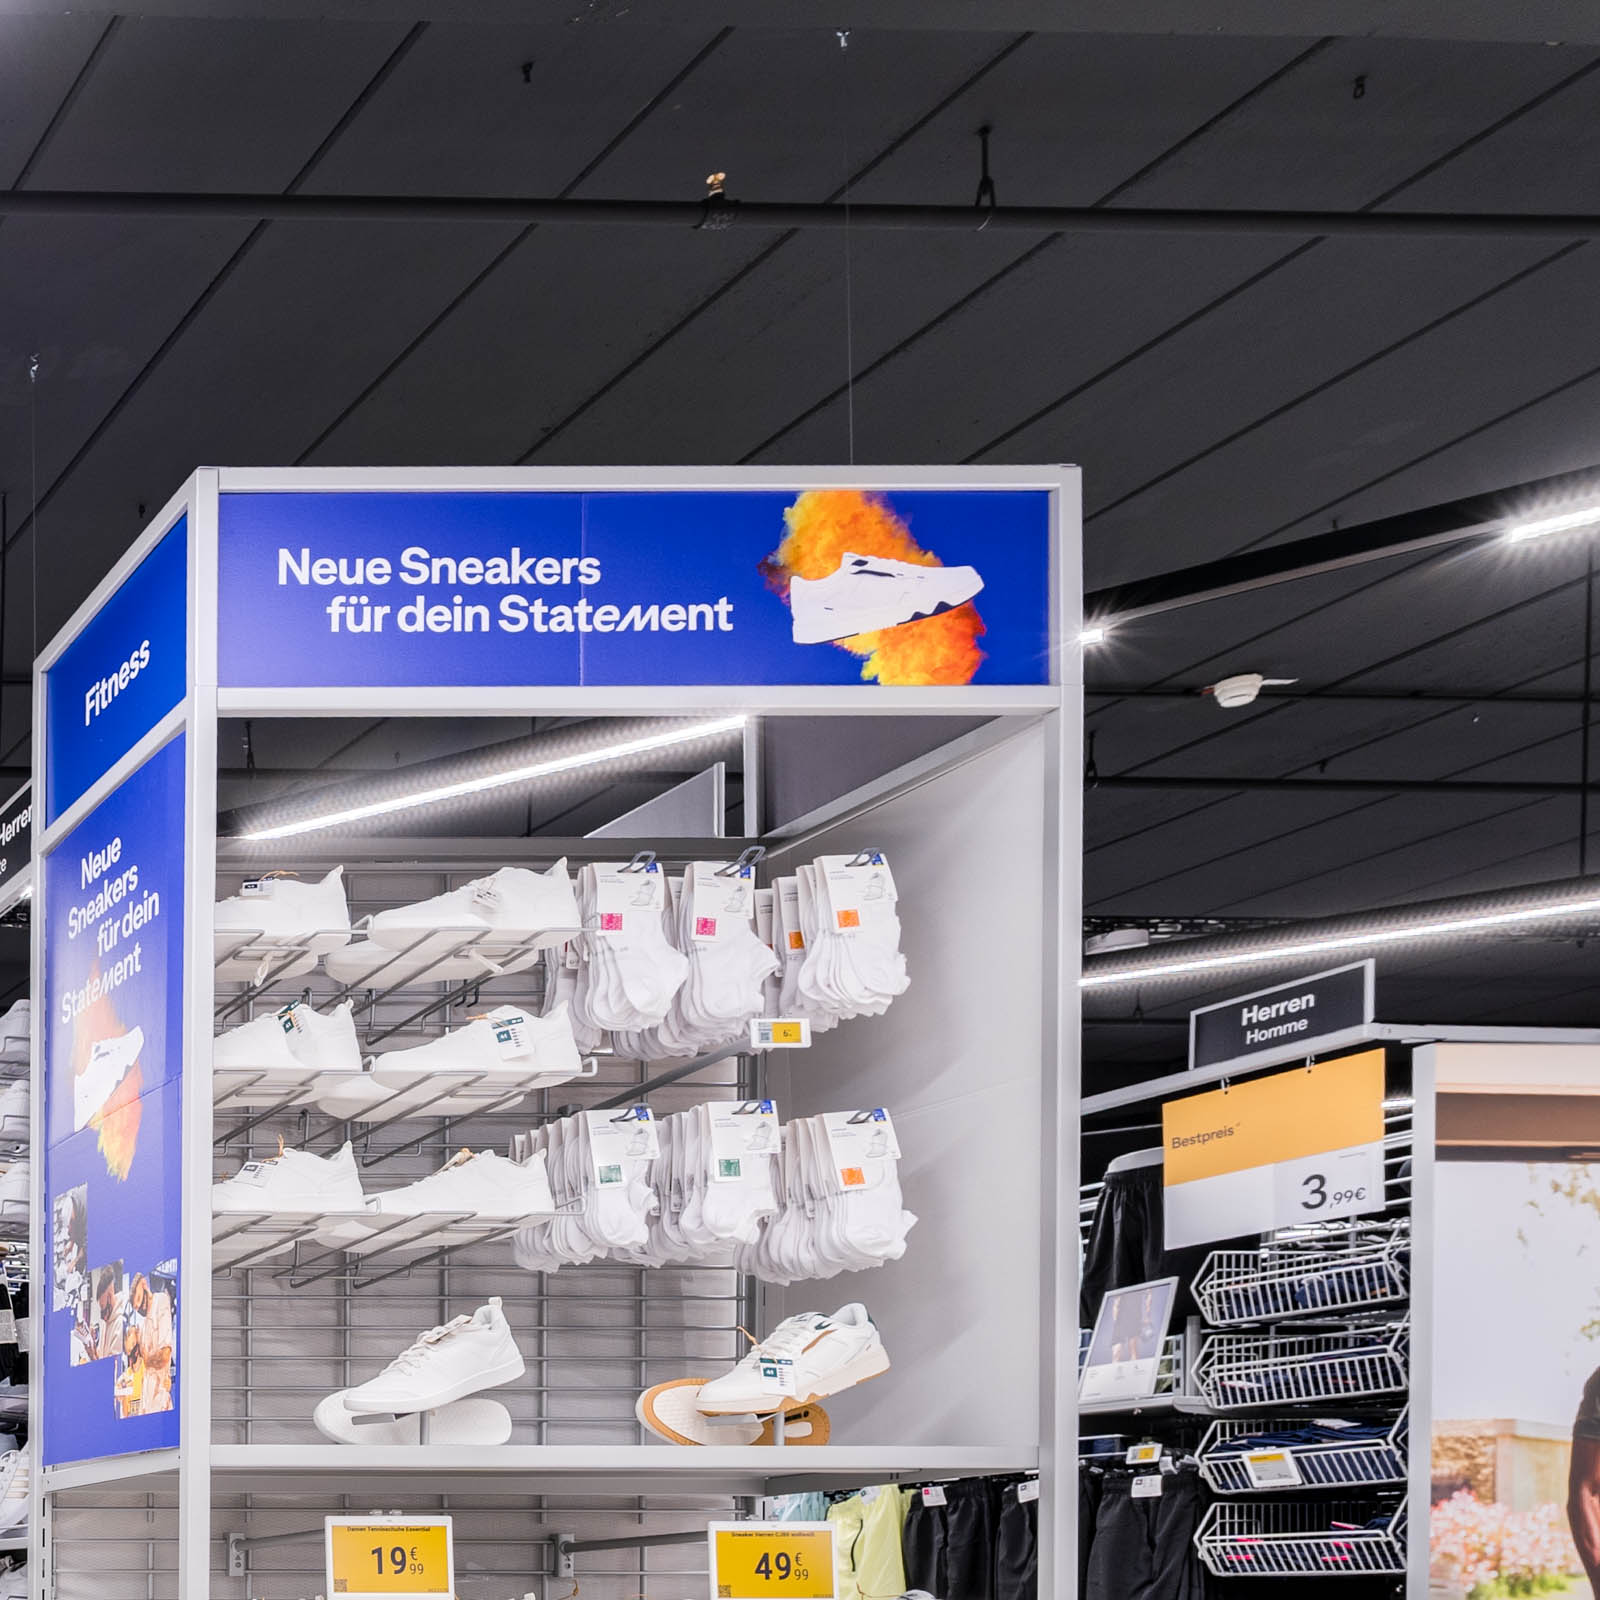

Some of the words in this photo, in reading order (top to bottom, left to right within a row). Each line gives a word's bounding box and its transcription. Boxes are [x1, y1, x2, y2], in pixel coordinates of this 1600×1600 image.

[278, 547, 392, 586] Neue
[401, 546, 600, 586] Sneakers
[326, 595, 391, 633] für
[398, 595, 491, 633] dein
[499, 596, 734, 634] Statement
[84, 639, 151, 727] Fitness
[80, 836, 122, 890] Neue
[68, 864, 139, 940] Sneakers
[97, 918, 120, 957] für
[121, 890, 160, 943] dein
[61, 944, 143, 1027] Statement
[1241, 993, 1315, 1027] Herren
[1246, 1018, 1308, 1045] Homme
[371, 1547, 407, 1575] 19
[410, 1547, 418, 1560] €
[410, 1563, 424, 1575] 99
[754, 1552, 791, 1580] 49
[795, 1552, 803, 1566] €
[794, 1569, 809, 1580] 99
